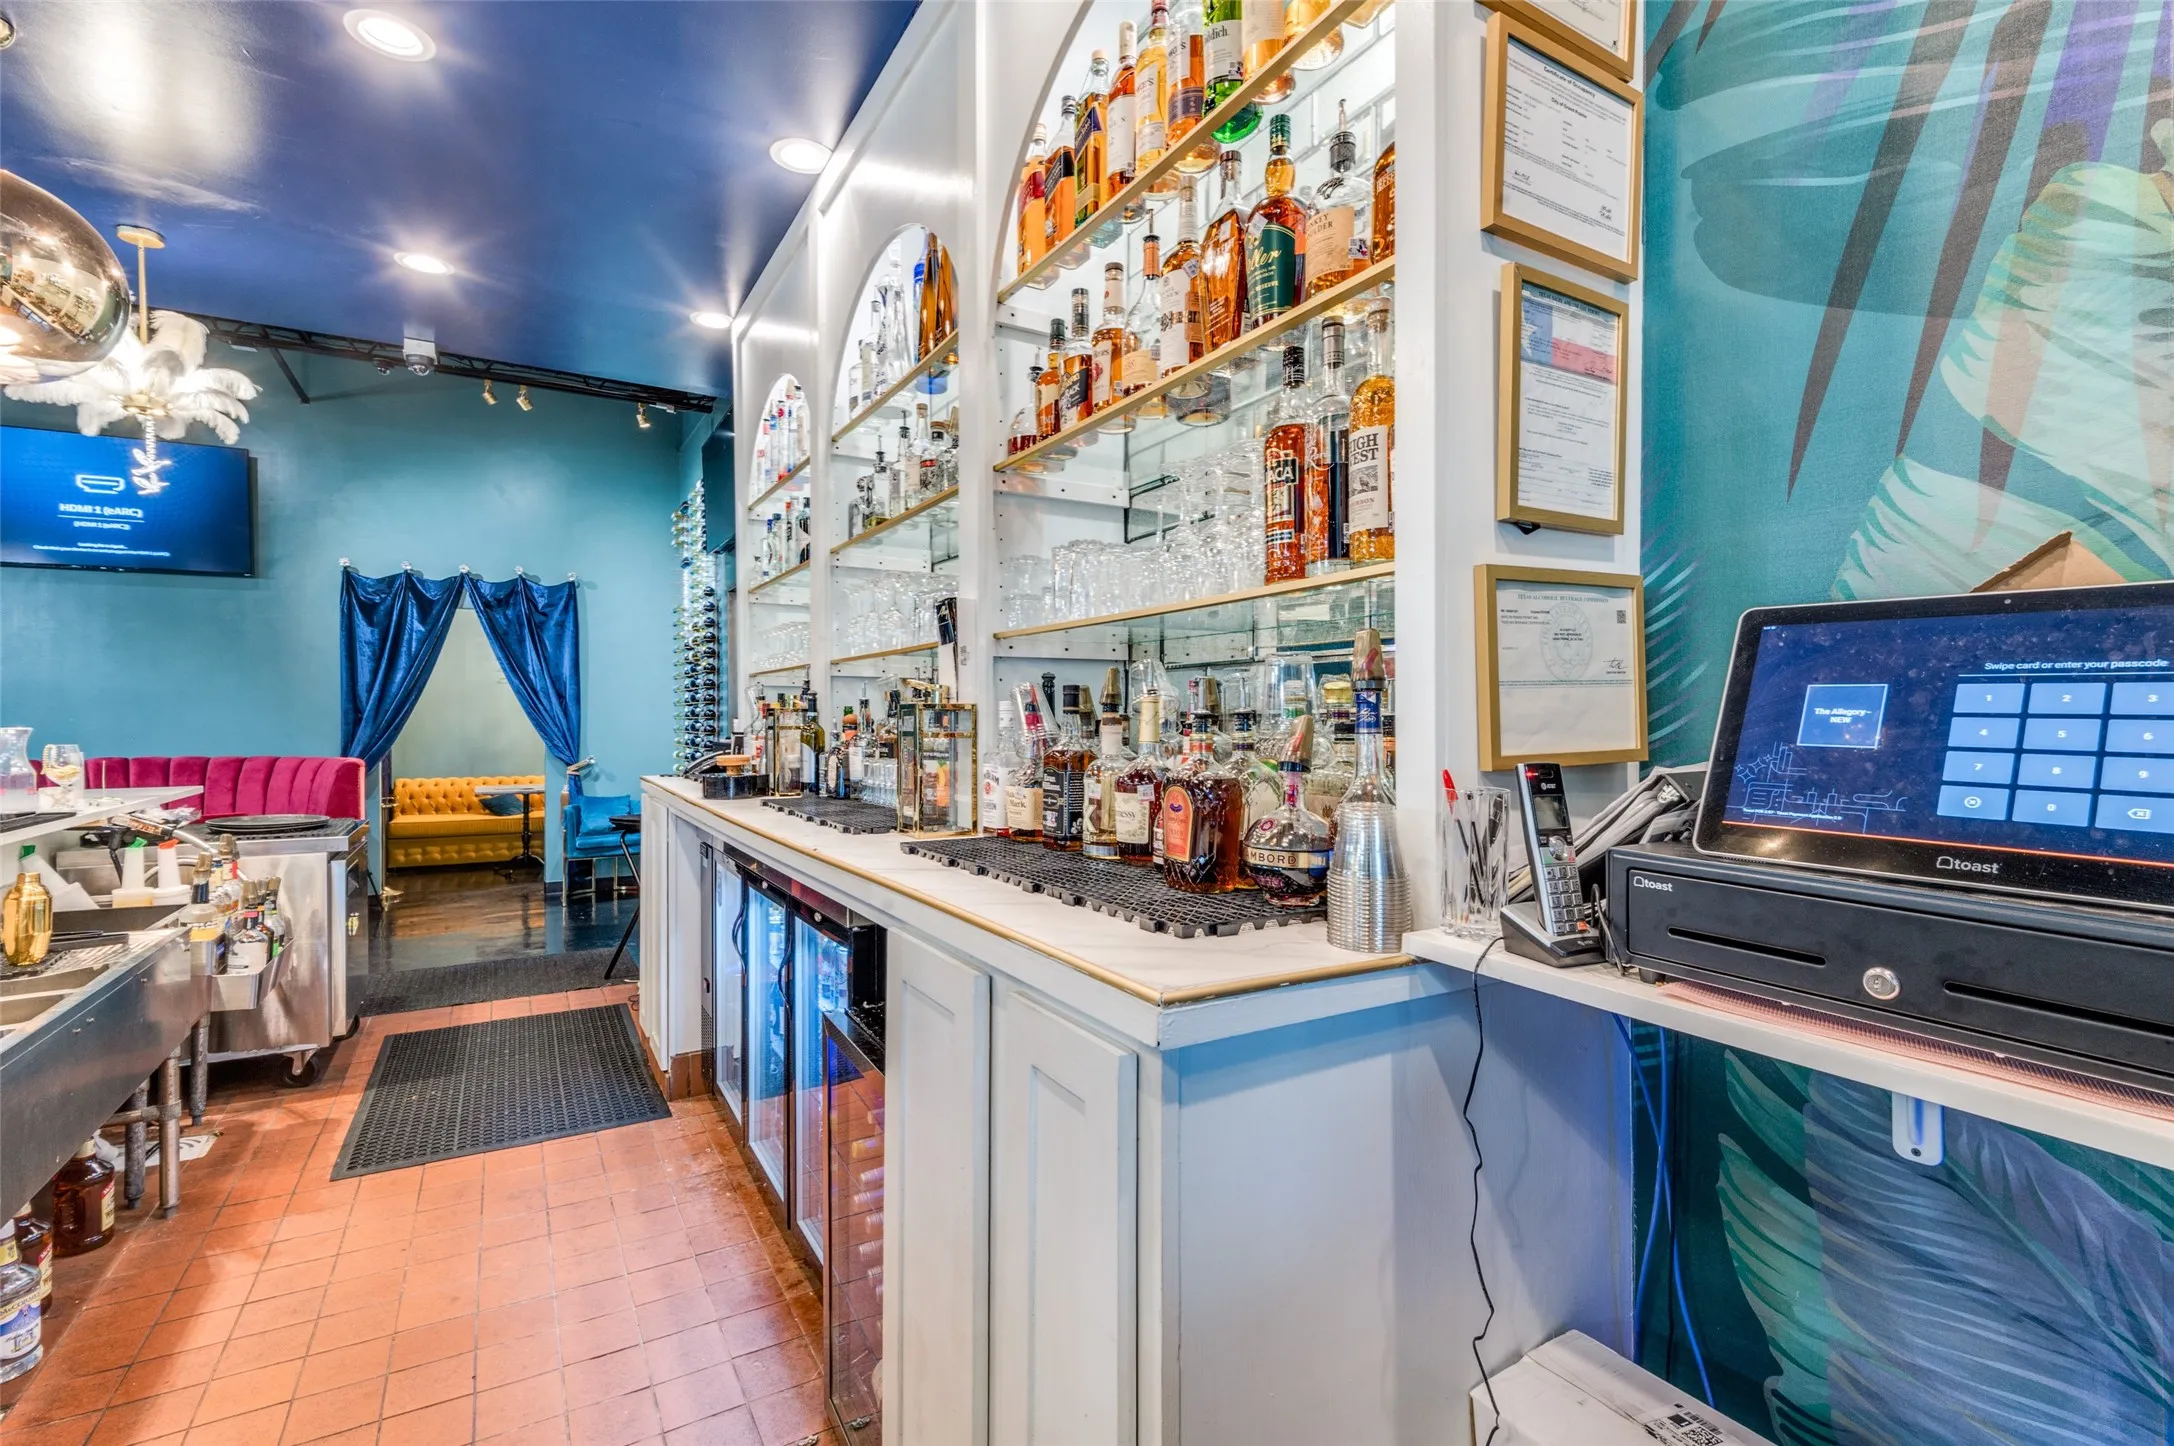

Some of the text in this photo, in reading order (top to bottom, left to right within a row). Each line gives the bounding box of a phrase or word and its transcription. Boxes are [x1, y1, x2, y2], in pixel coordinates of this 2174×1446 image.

[58, 502, 144, 518] HDMI 1 (eARC)
[1984, 658, 2169, 671] Swipe card or enter your passcode
[1985, 694, 1992, 702] 1
[2062, 694, 2072, 702] 2
[2148, 694, 2159, 702] 3
[1830, 708, 1866, 716] Allegory
[1830, 716, 1852, 724] NEW
[2057, 730, 2068, 738] 5
[2143, 732, 2154, 740] 6
[1974, 763, 1984, 771] 7
[2052, 767, 2062, 775] 8
[2138, 770, 2148, 778] 9
[2047, 804, 2057, 812] 0
[1245, 849, 1297, 866] AMBORD
[1954, 859, 1999, 874] toast
[1644, 878, 1672, 892] toast
